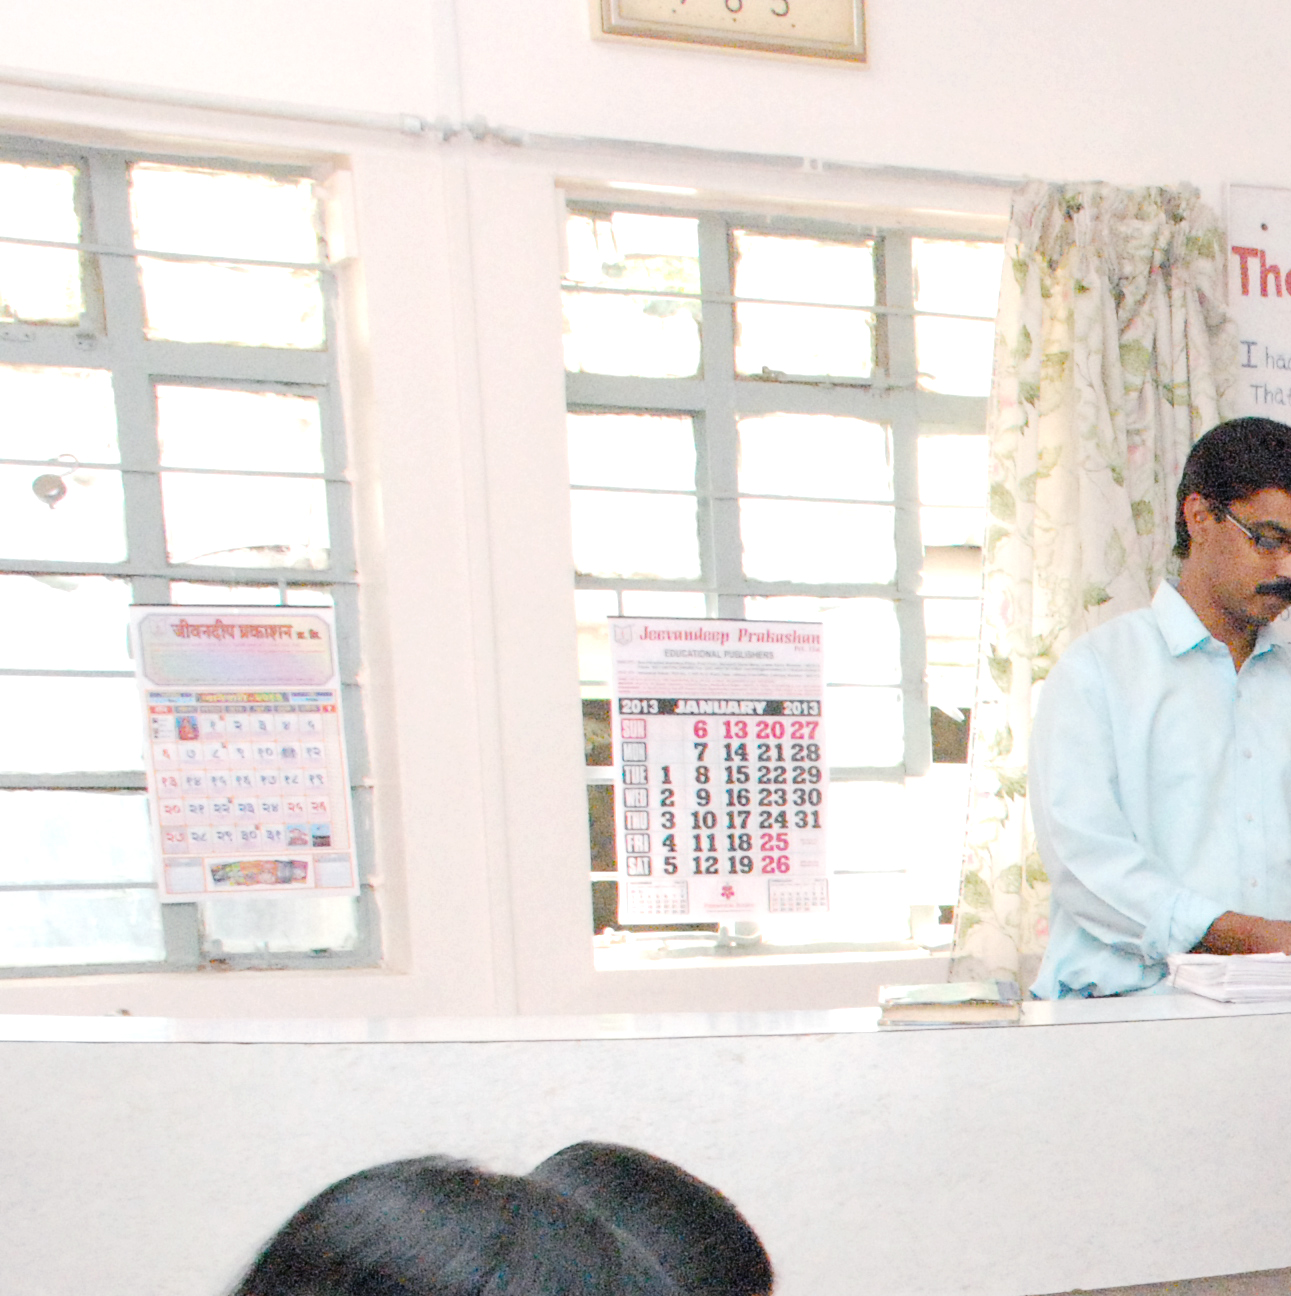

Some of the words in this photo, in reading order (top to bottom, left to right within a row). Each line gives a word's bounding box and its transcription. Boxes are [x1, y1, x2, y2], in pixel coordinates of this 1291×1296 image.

[1240, 340, 1258, 369] I
[663, 648, 722, 659] EDUCATIONAL
[723, 649, 774, 660] PUBLISHERS
[621, 699, 659, 714] 2013
[674, 700, 767, 714] JANUARY
[783, 701, 819, 715] 2013
[693, 720, 708, 739] 6
[723, 720, 749, 739] 13
[756, 720, 786, 739] 20
[790, 720, 819, 740] 27
[693, 742, 709, 762] 7
[724, 742, 750, 762] 14
[757, 743, 786, 762] 21
[790, 743, 820, 762] 28
[661, 765, 672, 785] 1
[695, 765, 711, 785] 8
[725, 765, 750, 785] 15
[757, 765, 787, 784] 22
[792, 765, 822, 784] 29
[660, 788, 675, 807] 2
[696, 788, 711, 807] 9
[725, 788, 751, 807] 16
[758, 788, 788, 807] 23
[792, 788, 822, 806] 30
[661, 811, 676, 830] 3
[691, 810, 718, 830] 10
[726, 810, 751, 829] 17
[758, 810, 788, 829] 24
[794, 810, 822, 829] 31
[662, 833, 677, 853] 4
[693, 833, 718, 853] 11
[727, 833, 753, 852] 18
[760, 832, 790, 852] 25
[663, 855, 678, 875] 5
[692, 855, 720, 875] 12
[728, 855, 754, 874] 19
[761, 855, 791, 874] 26
